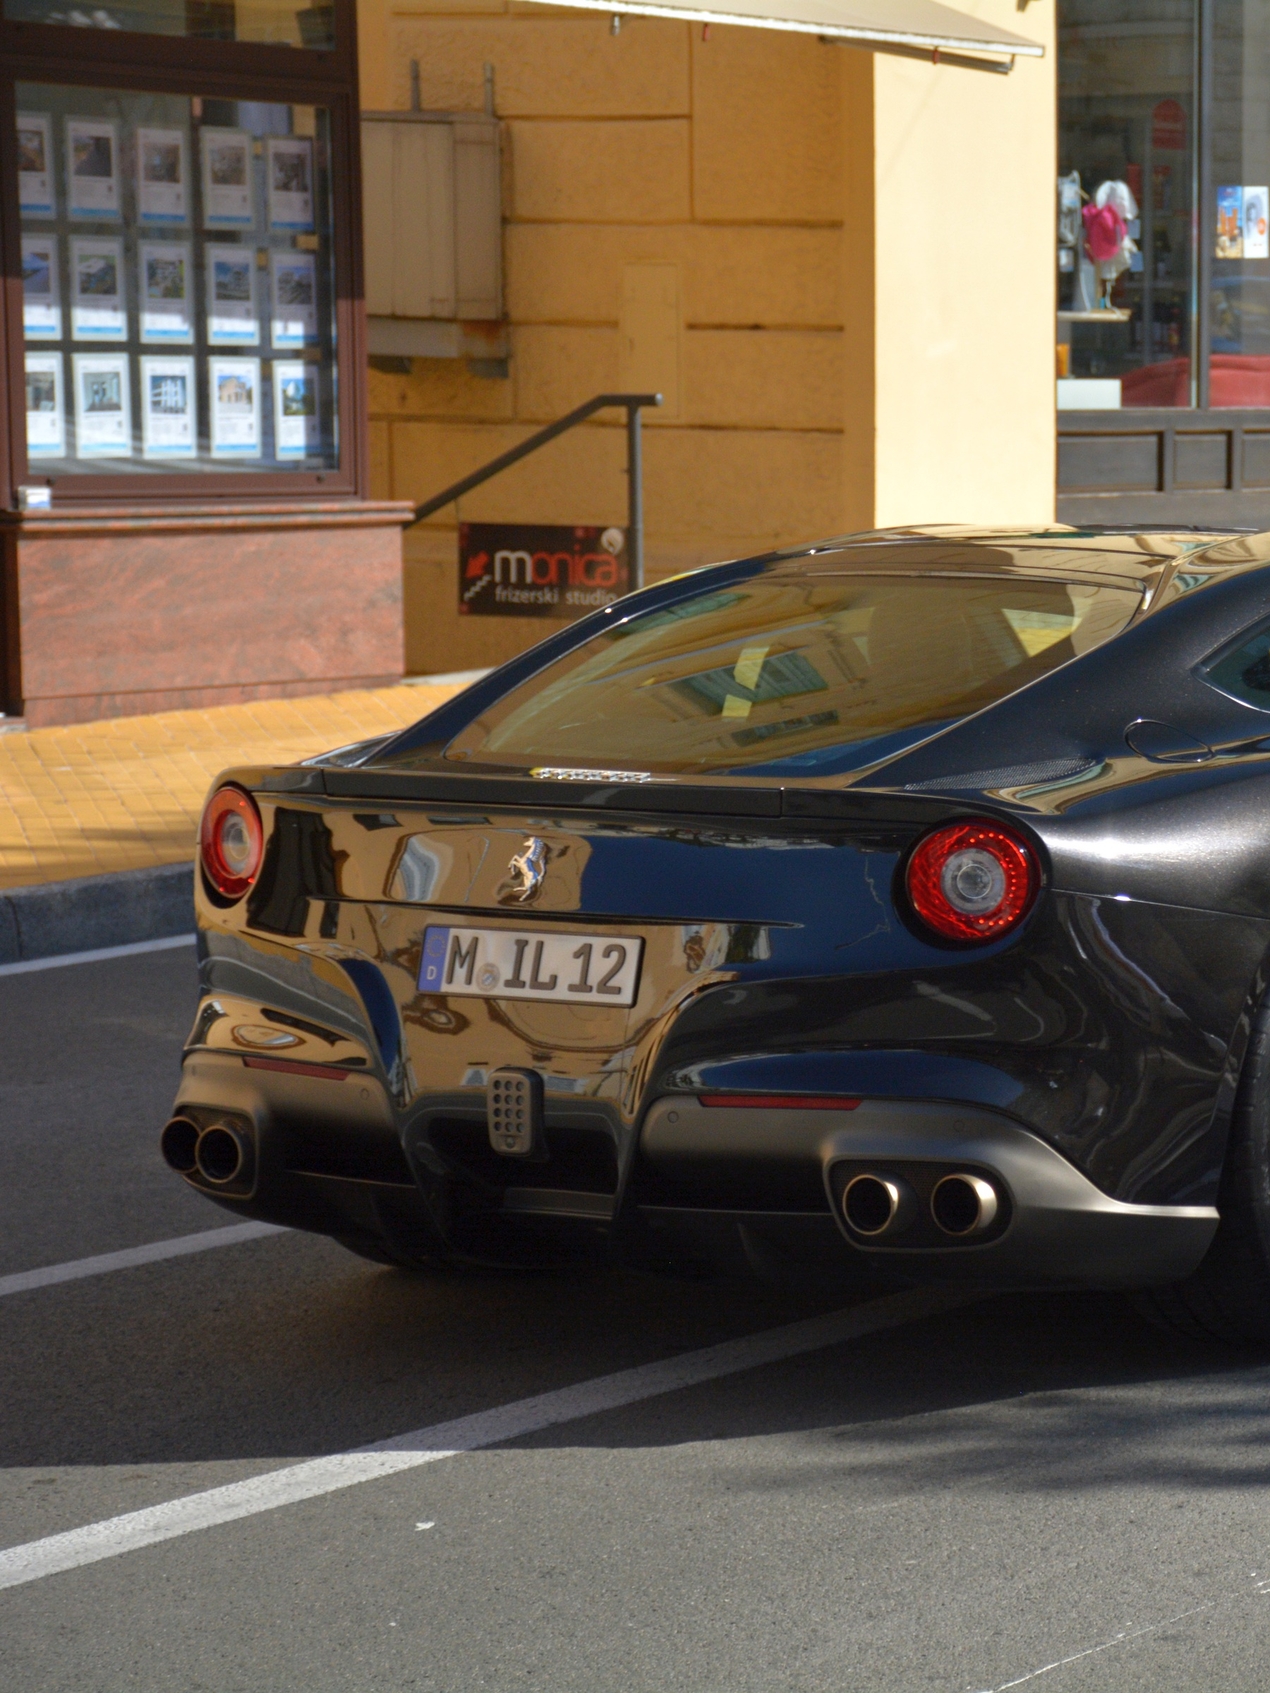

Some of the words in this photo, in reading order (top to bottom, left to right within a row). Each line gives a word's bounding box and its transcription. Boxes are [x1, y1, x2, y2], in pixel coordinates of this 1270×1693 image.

[494, 543, 619, 587] monica
[495, 586, 559, 605] frizerski
[566, 588, 617, 606] studio
[426, 965, 437, 981] D
[445, 935, 479, 986] M
